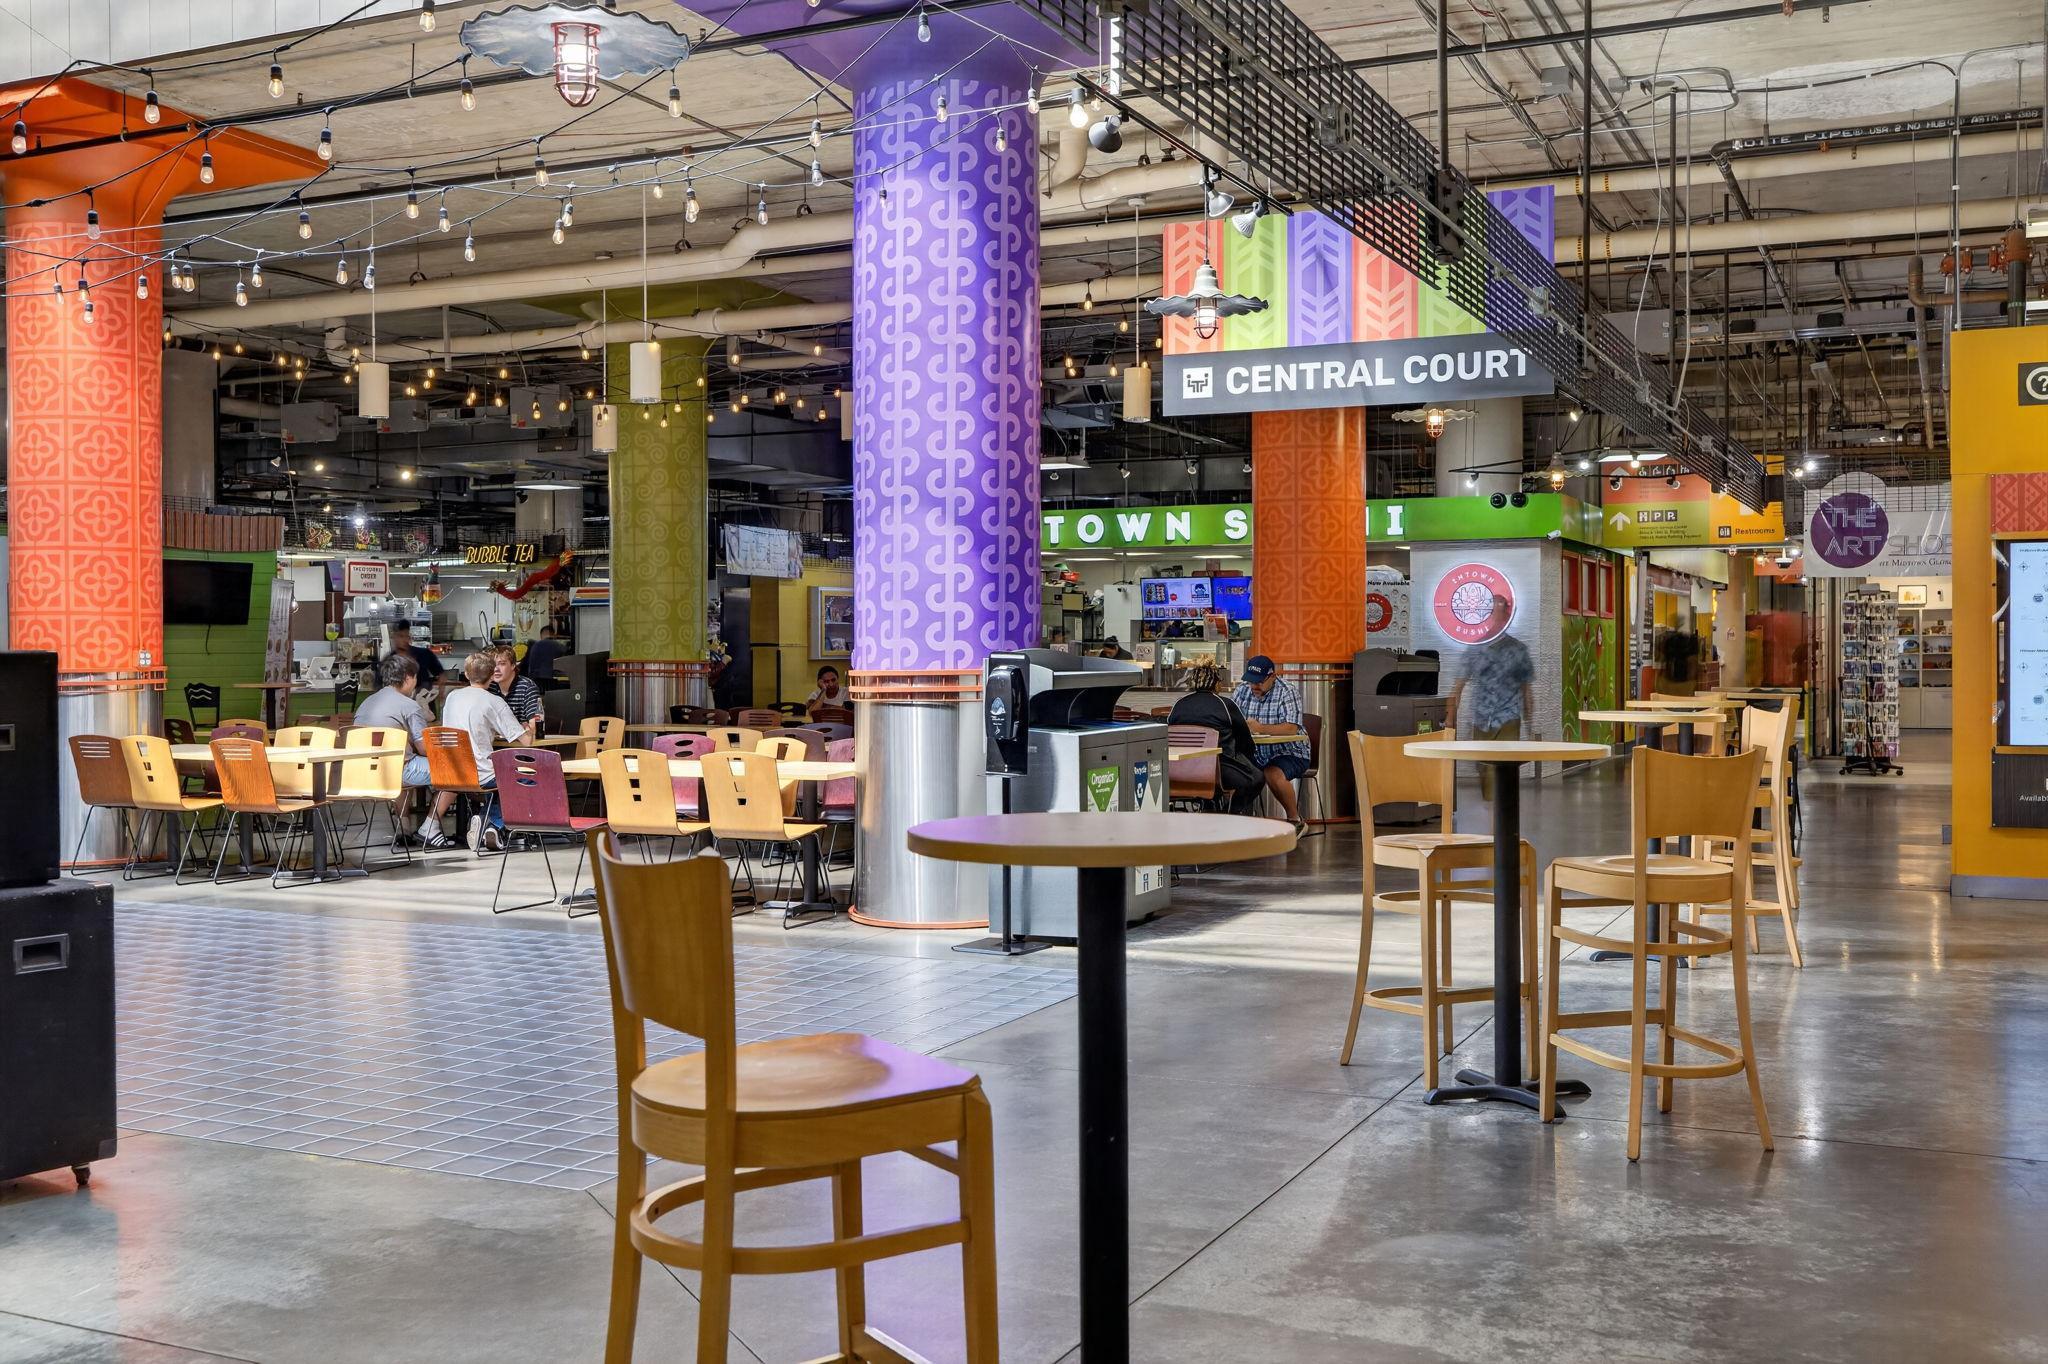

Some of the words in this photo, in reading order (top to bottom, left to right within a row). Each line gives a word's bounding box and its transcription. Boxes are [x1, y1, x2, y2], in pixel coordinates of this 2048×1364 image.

[1226, 357, 1396, 395] CENTRAL
[1403, 348, 1527, 384] COURT
[1825, 507, 1877, 528] THE
[465, 545, 510, 564] BUBBLE
[514, 544, 534, 562] TEA
[1824, 535, 1882, 556] ART
[1456, 625, 1490, 636] SUSHI
